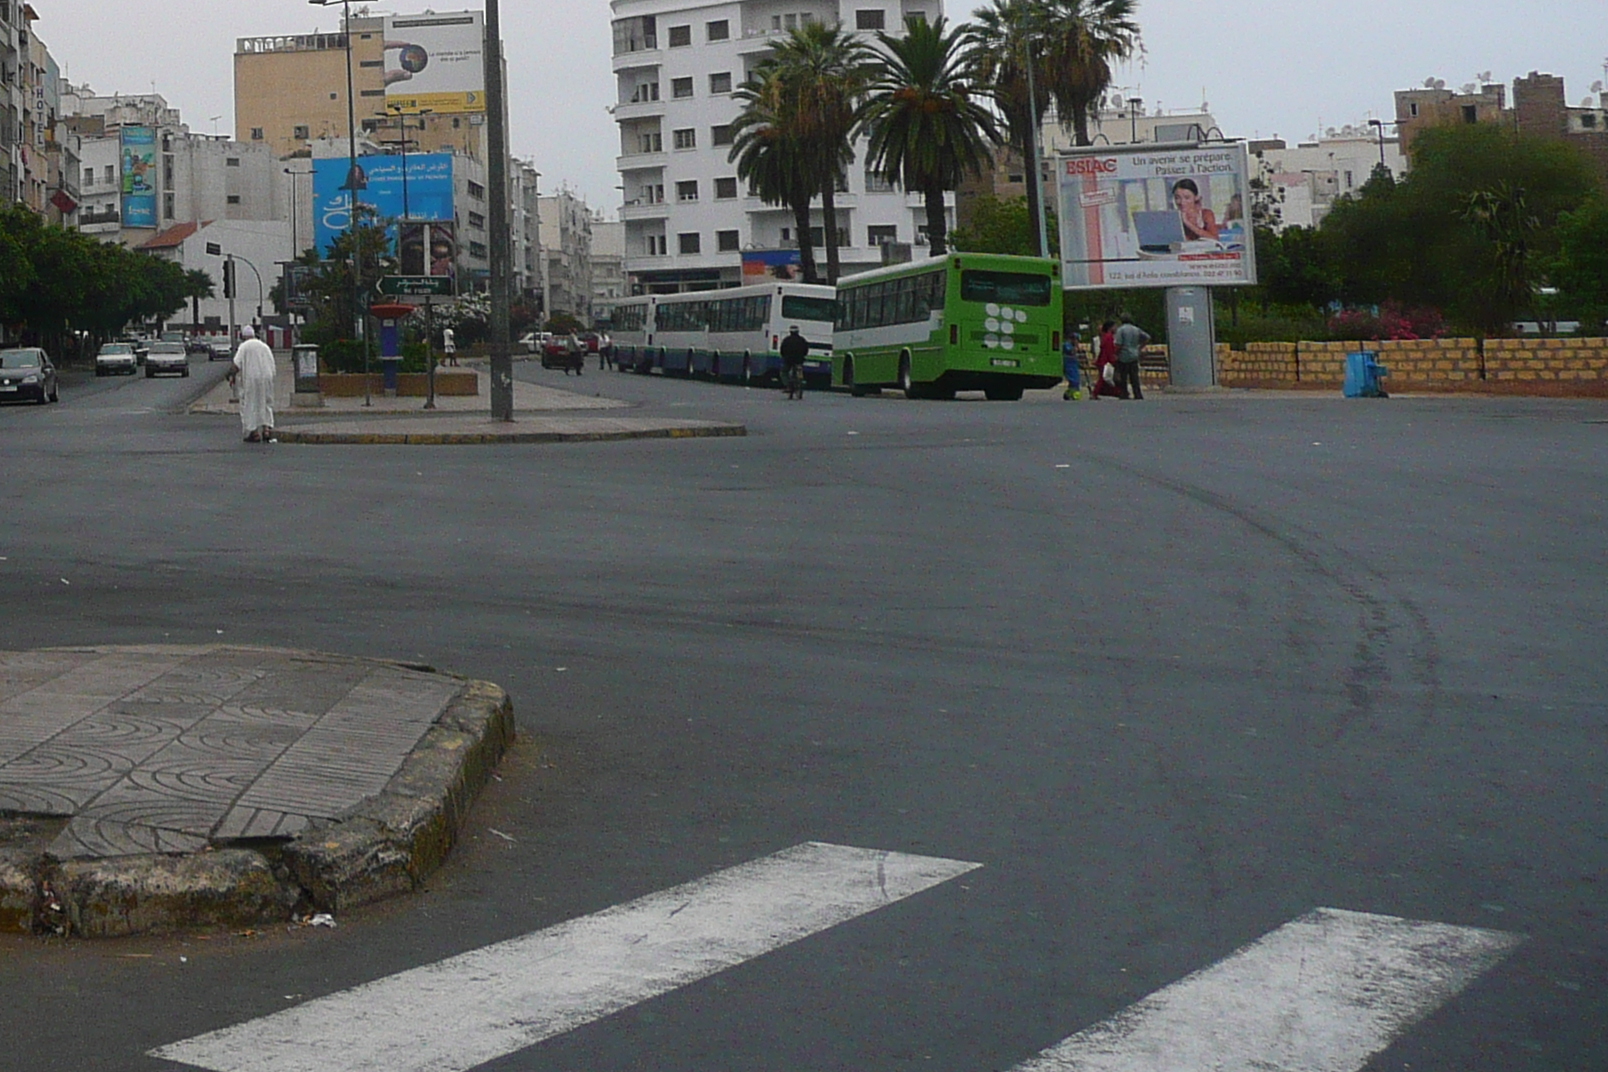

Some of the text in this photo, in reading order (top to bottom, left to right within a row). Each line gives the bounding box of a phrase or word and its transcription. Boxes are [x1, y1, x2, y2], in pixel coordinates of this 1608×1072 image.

[36, 88, 44, 145] HOTEL
[1066, 158, 1118, 175] ESIAC
[1133, 157, 1146, 166] Un
[1149, 156, 1176, 165] avenir
[1180, 156, 1190, 164] se
[1156, 166, 1185, 175] Passez
